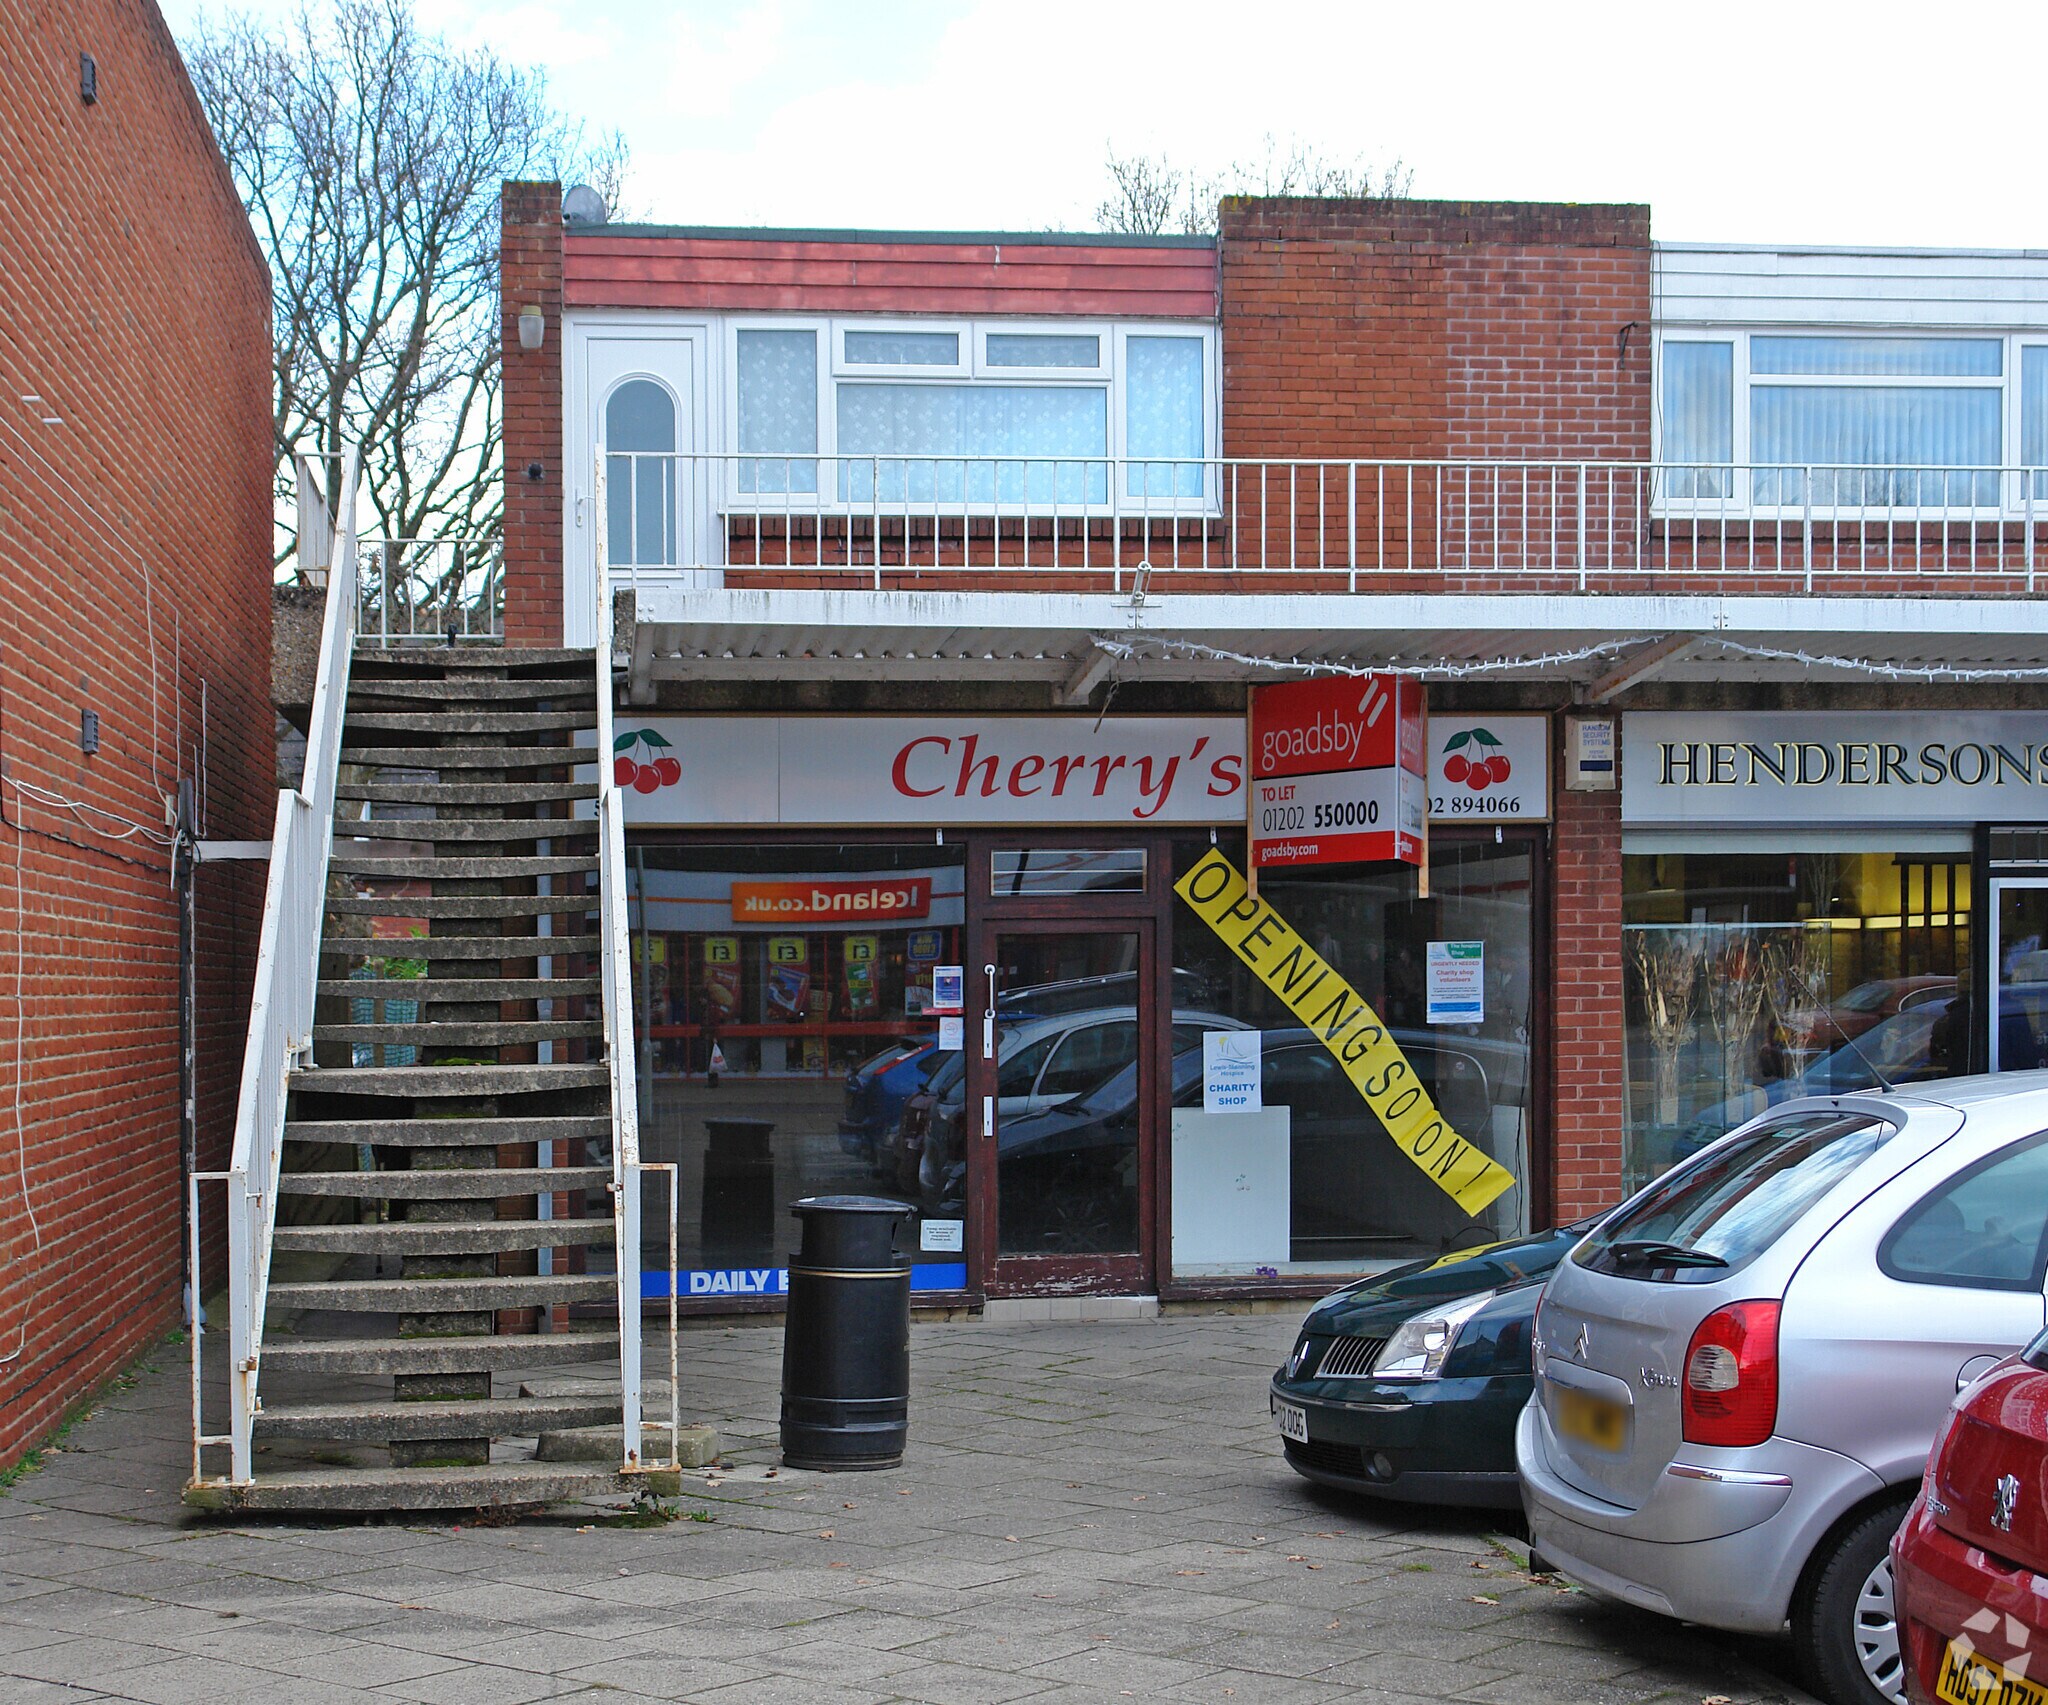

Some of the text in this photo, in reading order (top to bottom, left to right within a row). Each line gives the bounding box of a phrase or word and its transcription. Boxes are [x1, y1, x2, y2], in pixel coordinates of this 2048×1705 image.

[1261, 709, 1364, 772] goadsby
[892, 734, 1243, 818] Cherry's
[1261, 785, 1296, 801] TO LET
[1263, 805, 1305, 832] 01202
[1314, 799, 1379, 828] 550000
[1451, 796, 1520, 813] 894066
[1261, 842, 1319, 862] goadsby.com
[1188, 861, 1383, 1065] OPENING
[1209, 1083, 1256, 1092] CHARITY
[1218, 1096, 1247, 1106] SHOP
[690, 1270, 770, 1294] DAILY
